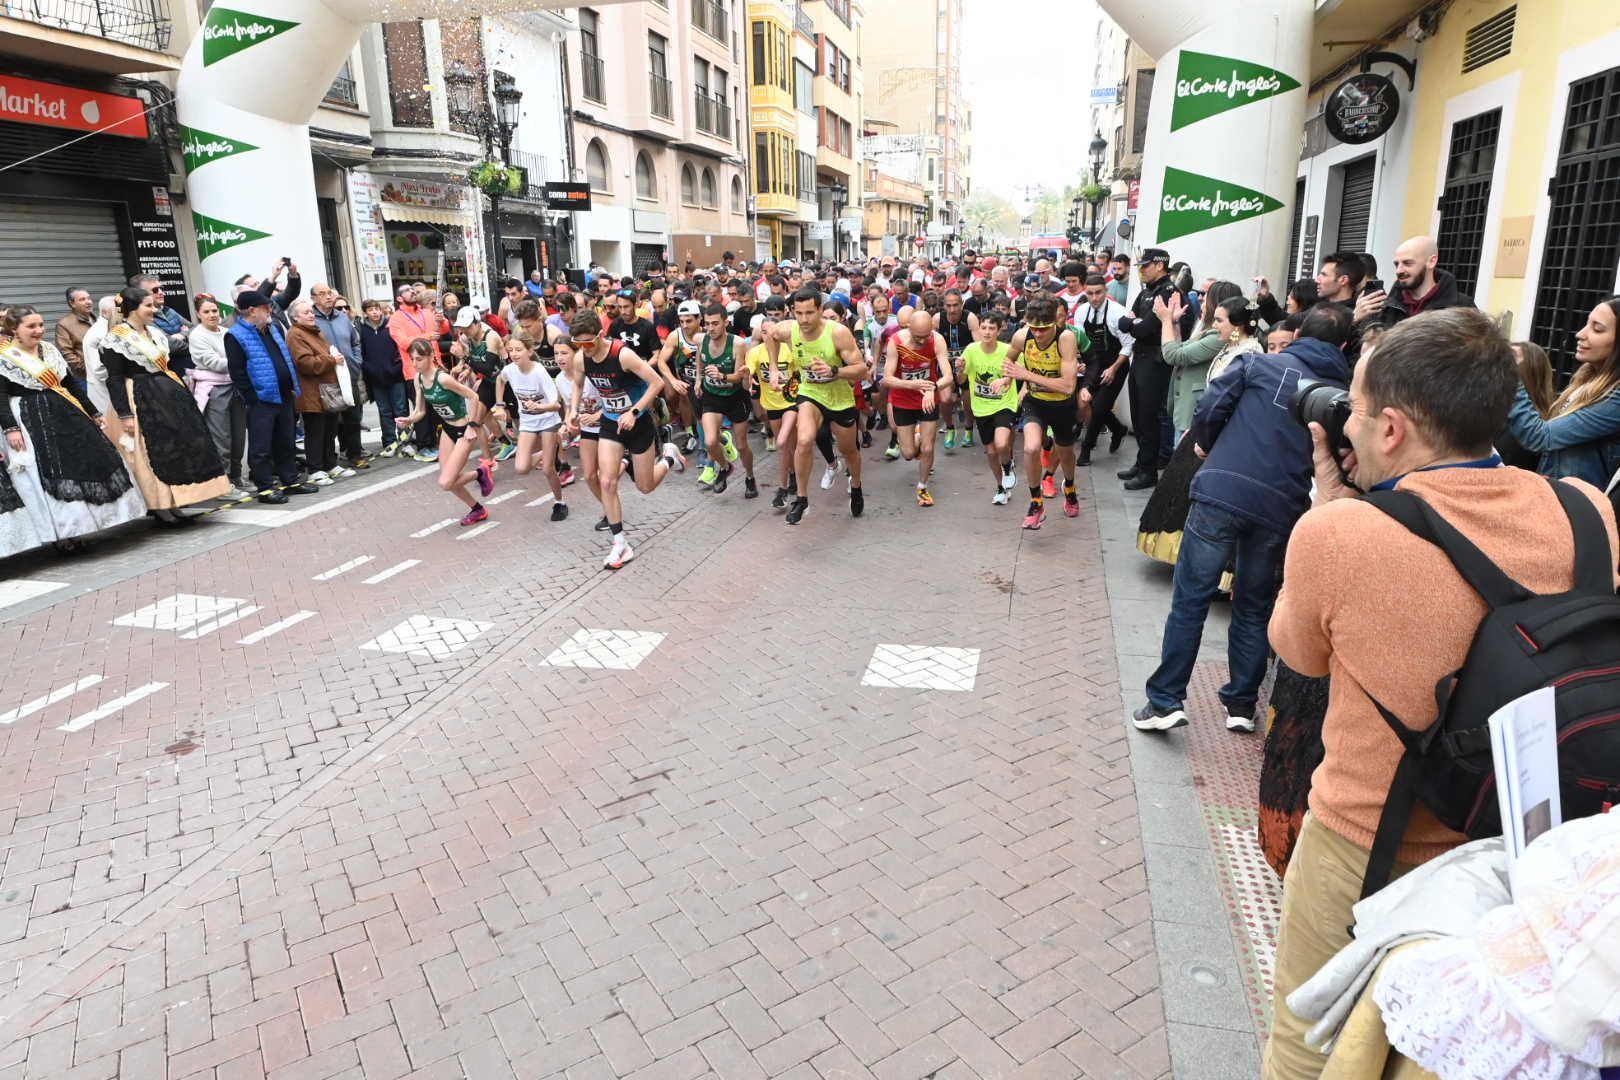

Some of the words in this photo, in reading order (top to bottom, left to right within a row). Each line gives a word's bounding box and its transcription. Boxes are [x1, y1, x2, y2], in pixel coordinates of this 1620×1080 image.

[212, 24, 235, 38] Corte
[1177, 79, 1190, 97] El
[1190, 77, 1227, 95] Corte
[1227, 69, 1281, 99] Inglés
[1163, 194, 1176, 212] El
[1176, 194, 1211, 212] Corte
[1211, 189, 1265, 217] Inglés
